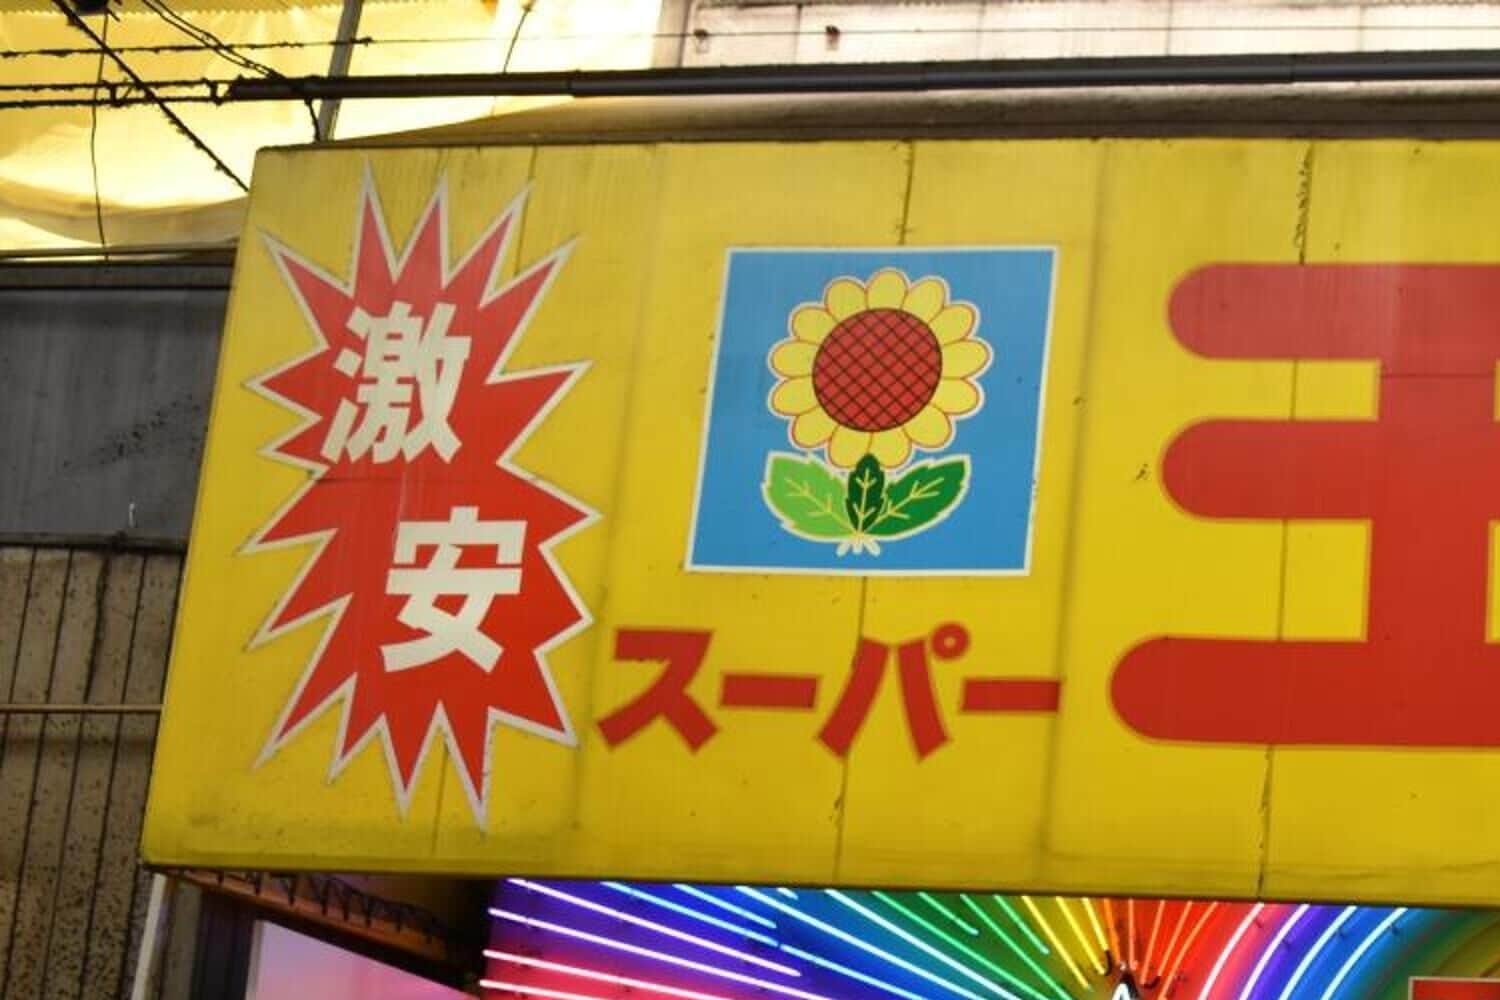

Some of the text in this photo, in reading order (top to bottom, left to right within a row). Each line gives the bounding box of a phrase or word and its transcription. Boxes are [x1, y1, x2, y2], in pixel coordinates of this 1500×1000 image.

[321, 302, 527, 672] 激安
[596, 621, 1062, 762] スーパー
